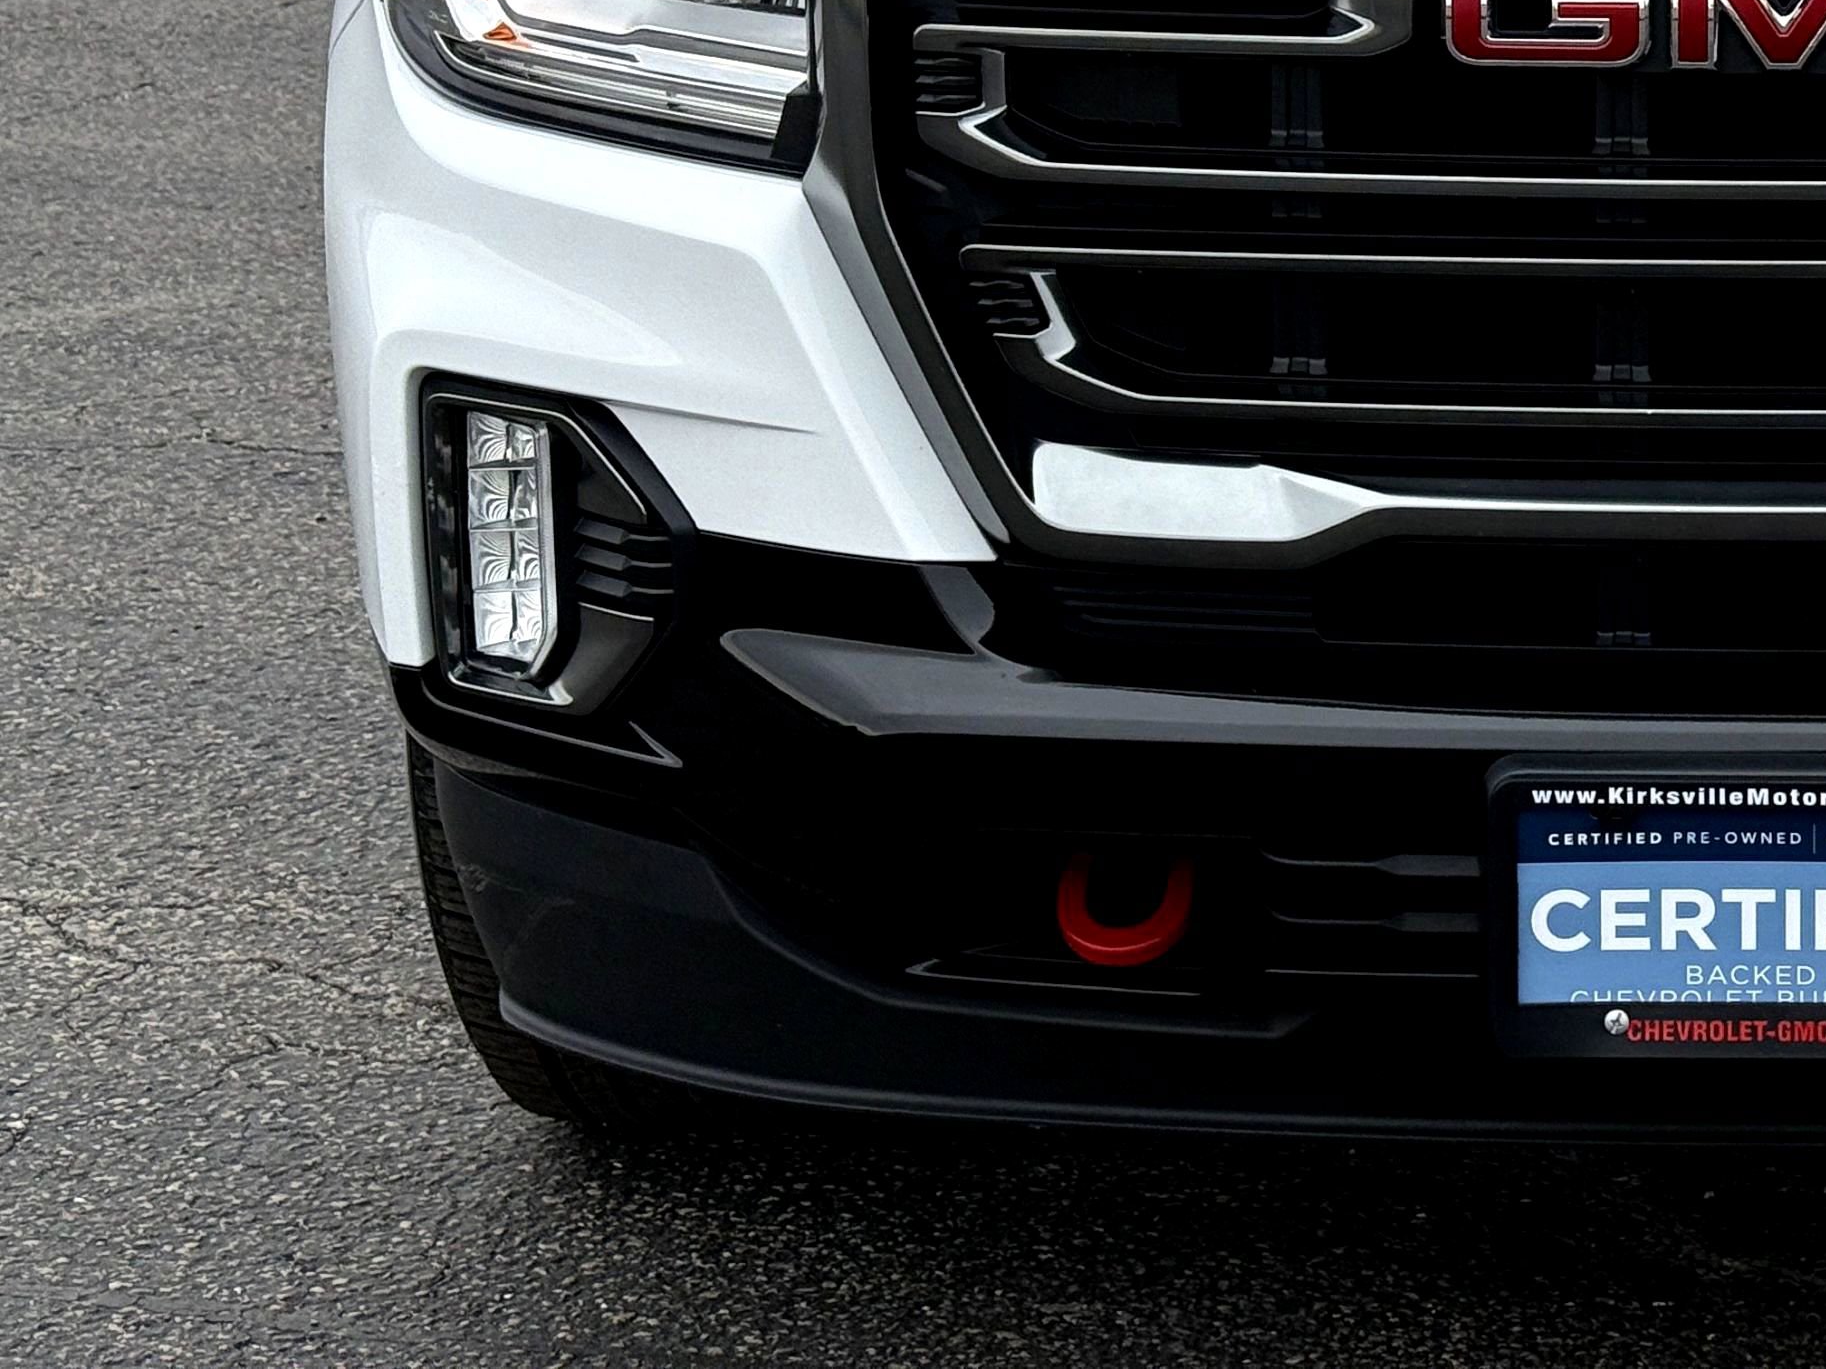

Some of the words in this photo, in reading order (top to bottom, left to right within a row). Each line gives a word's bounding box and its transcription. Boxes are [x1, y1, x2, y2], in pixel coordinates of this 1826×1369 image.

[1548, 832, 1663, 846] CERTIFIED
[1673, 831, 1802, 845] PRE-OWNED
[1686, 964, 1816, 986] BACKED
